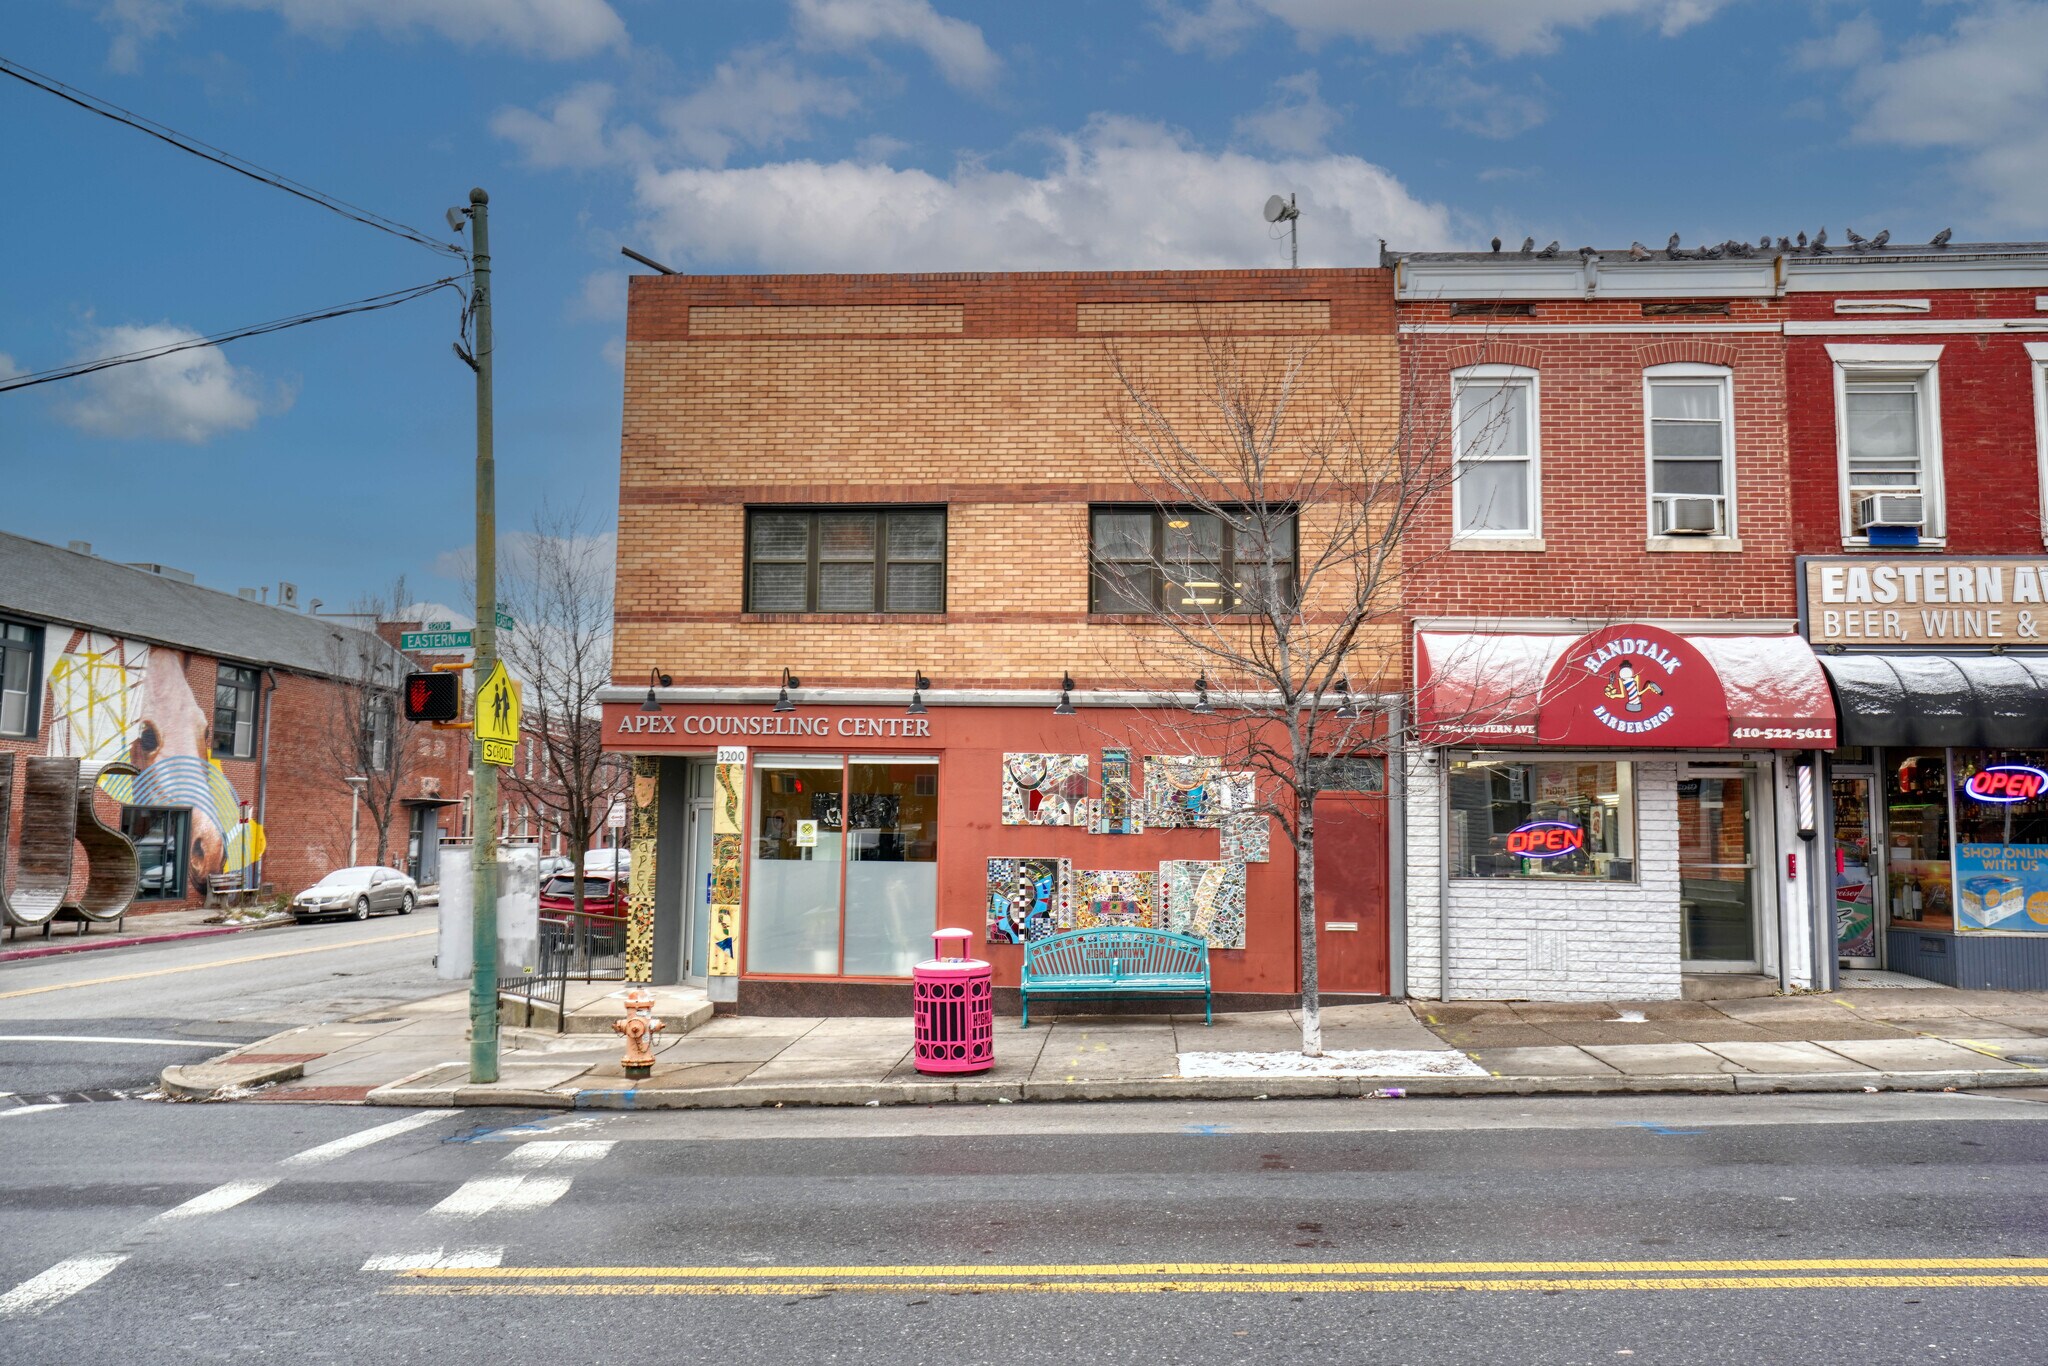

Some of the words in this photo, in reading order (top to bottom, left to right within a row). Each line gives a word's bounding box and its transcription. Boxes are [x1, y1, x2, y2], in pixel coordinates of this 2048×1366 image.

[1821, 566, 2004, 604] EASTERN
[1823, 610, 1909, 642] BEER,
[1920, 610, 2004, 638] WINE
[2016, 609, 2040, 638] &
[407, 633, 456, 648] EASTERN
[1583, 638, 1682, 675] HANDTALK
[617, 715, 677, 734] APEX
[683, 716, 829, 736] COUNSELING
[837, 717, 931, 737] CENTER
[1592, 705, 1675, 733] BARBERSHOP
[1463, 724, 1512, 734] EASTERN
[1513, 725, 1536, 734] AVE
[1732, 727, 1833, 740] 410-522-5611
[486, 744, 512, 761] SCHOOL
[719, 750, 745, 762] 3200
[1970, 770, 2042, 798] OPEN
[1506, 827, 1584, 852] OPEN
[1962, 847, 2001, 859] SHOP
[1982, 860, 2018, 871] WITH
[2021, 860, 2040, 871] US
